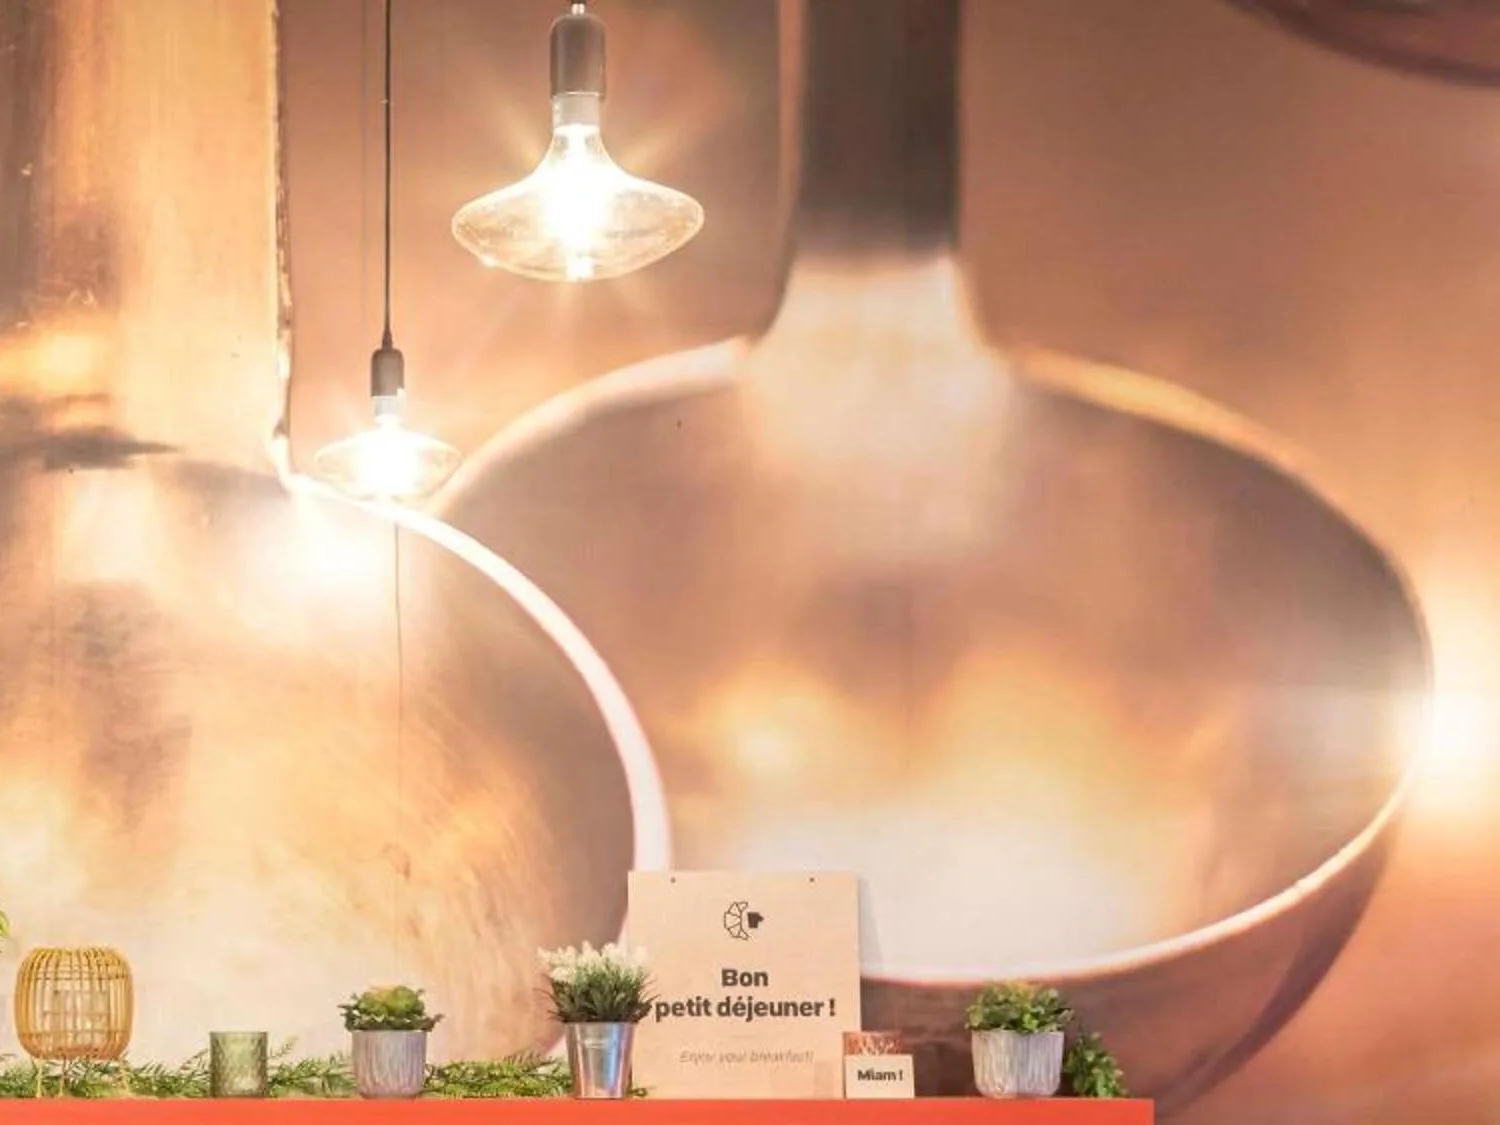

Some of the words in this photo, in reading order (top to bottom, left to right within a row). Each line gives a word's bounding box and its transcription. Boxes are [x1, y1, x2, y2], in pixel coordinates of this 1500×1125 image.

[721, 968, 769, 987] Bon
[655, 996, 713, 1023] petit
[716, 996, 825, 1023] déjeuner
[829, 998, 836, 1017] !
[857, 1067, 897, 1081] Miam
